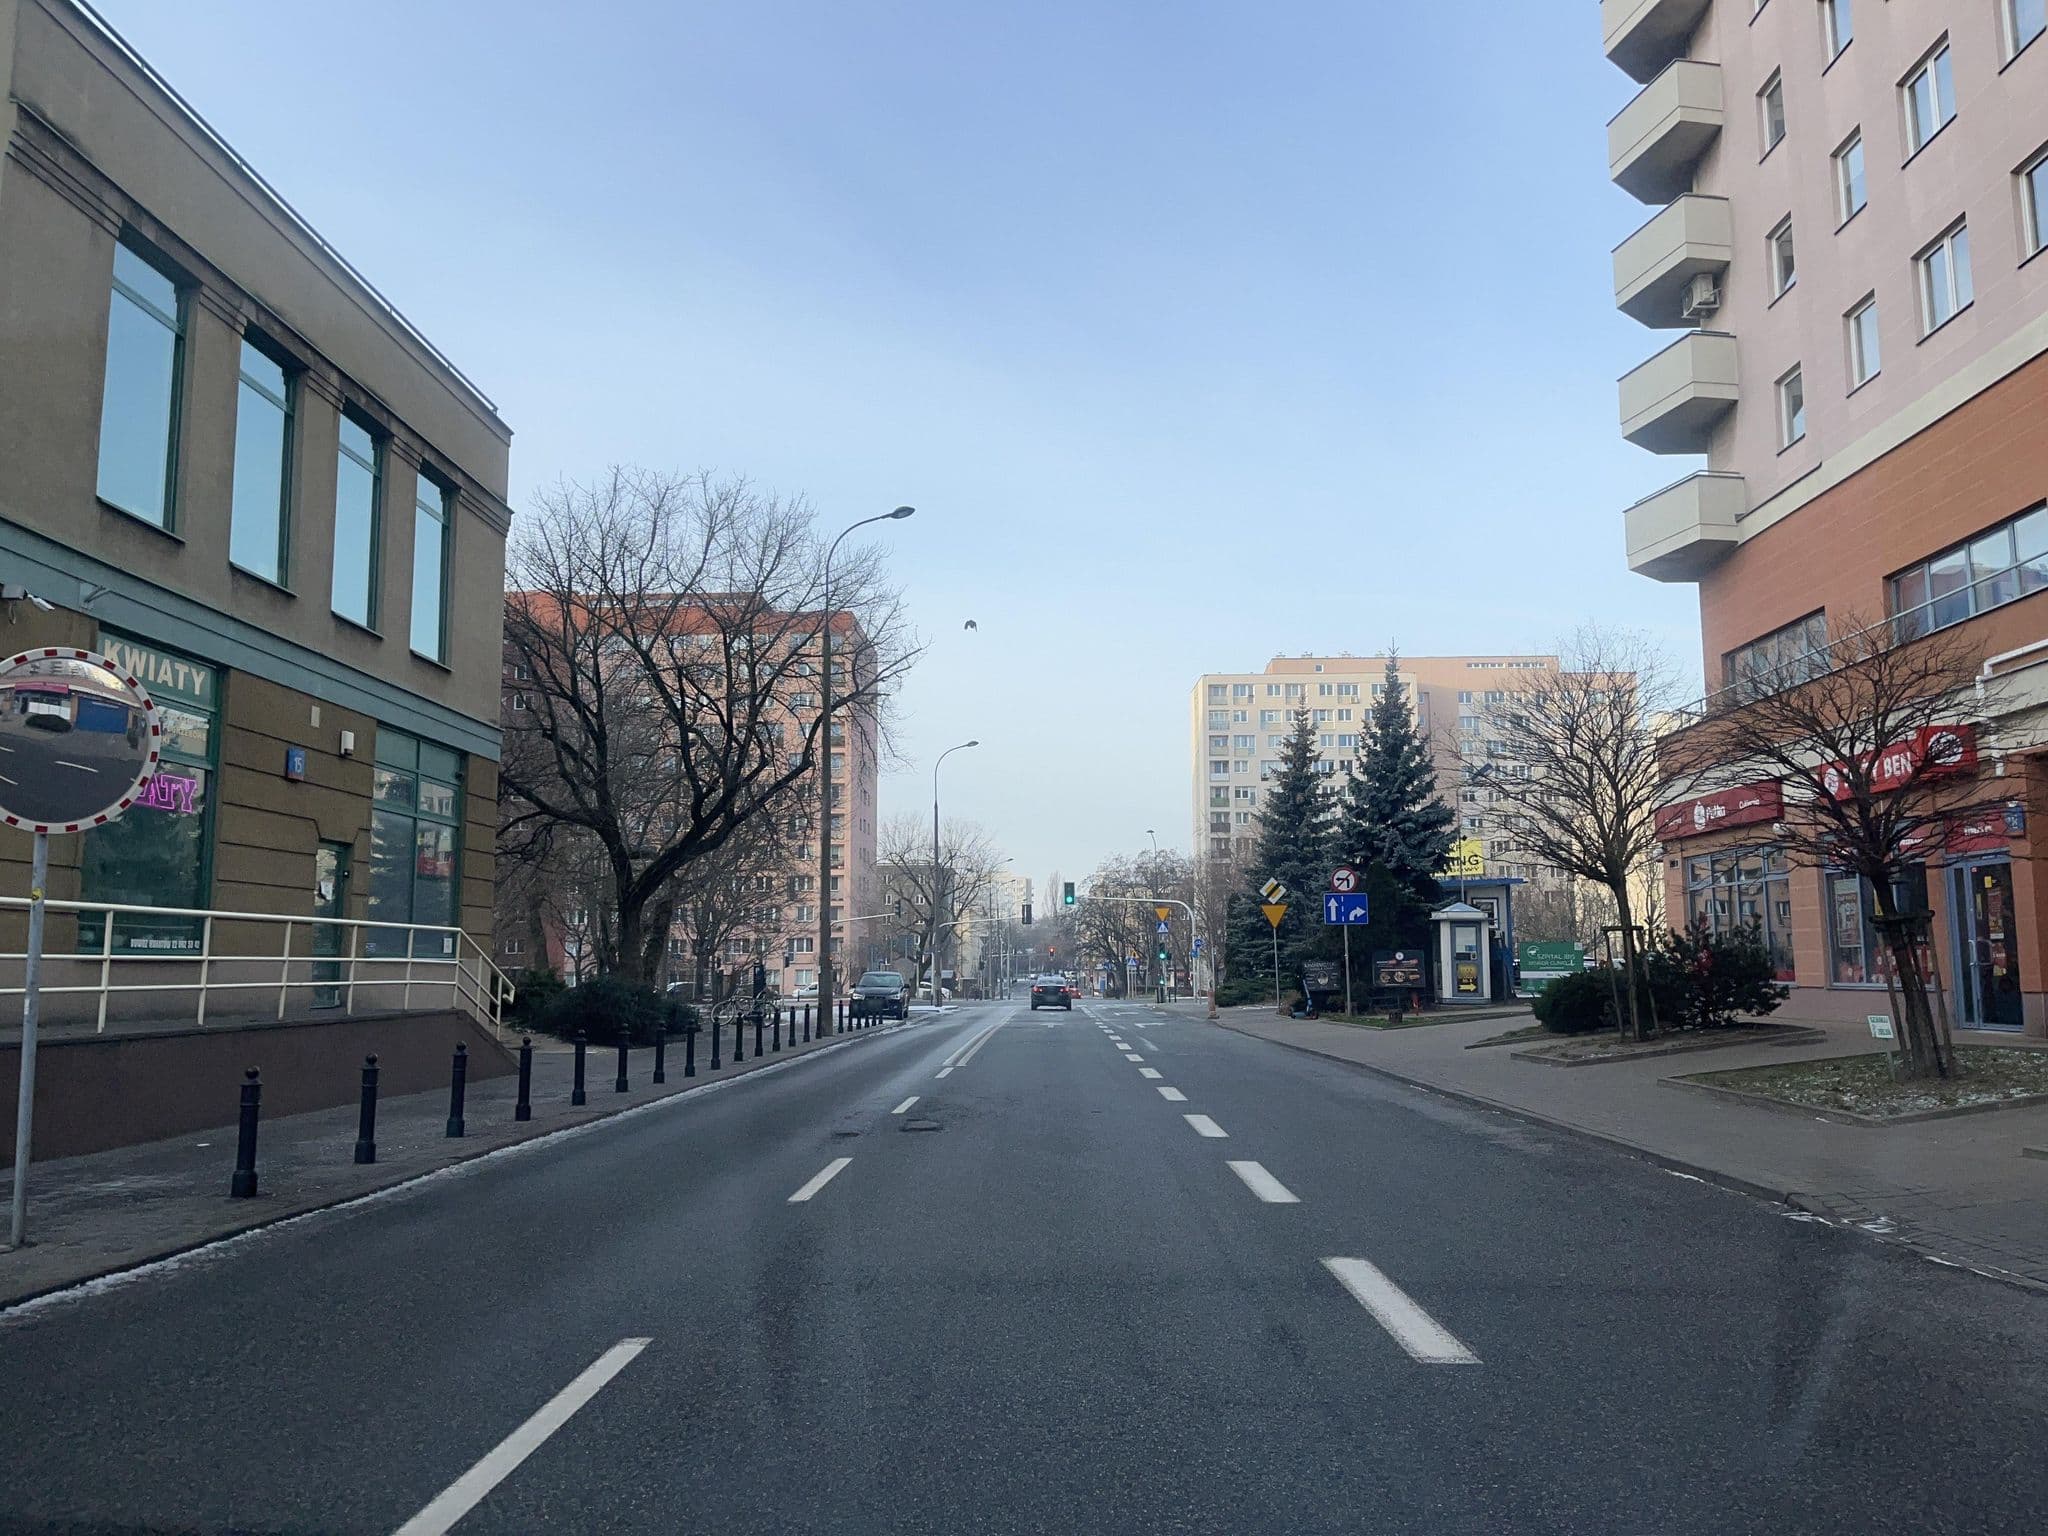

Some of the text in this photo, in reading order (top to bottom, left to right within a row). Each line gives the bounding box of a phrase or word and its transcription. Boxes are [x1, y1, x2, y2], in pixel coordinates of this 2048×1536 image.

[104, 639, 206, 696] KWIATY
[294, 757, 302, 773] 15
[1883, 751, 1913, 780] BEN
[134, 773, 198, 813] ATY
